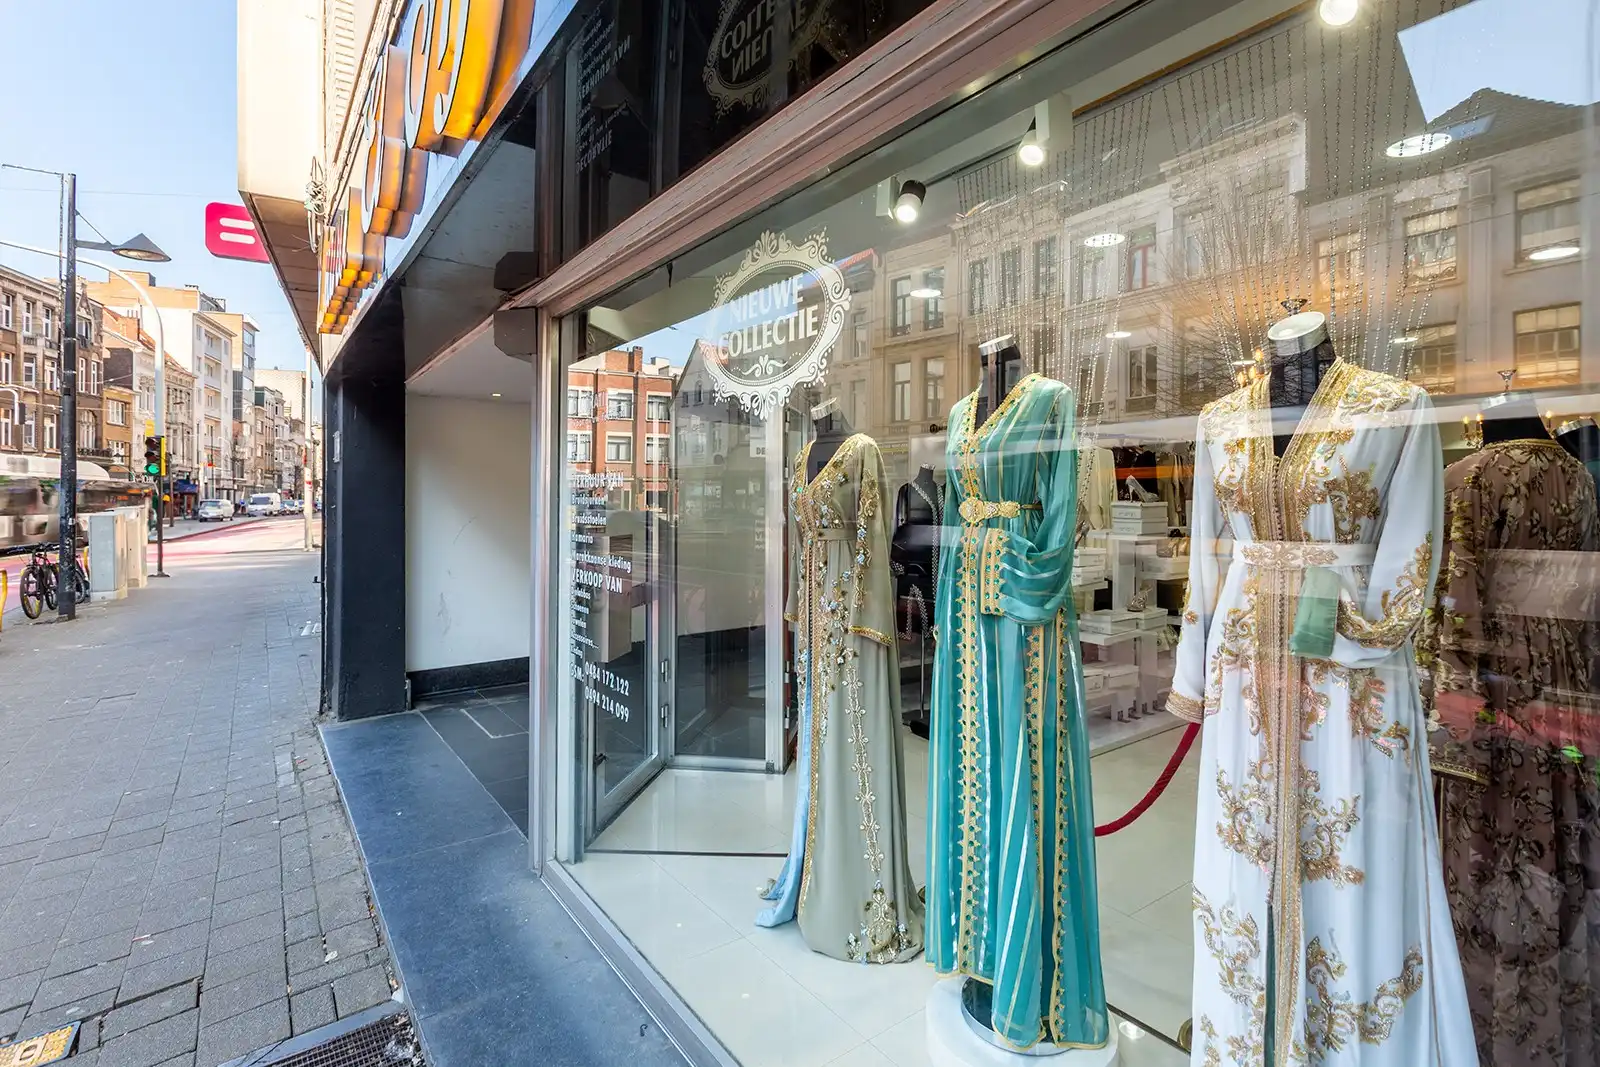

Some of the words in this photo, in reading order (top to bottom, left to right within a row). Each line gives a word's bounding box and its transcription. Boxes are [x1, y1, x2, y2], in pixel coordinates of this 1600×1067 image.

[730, 272, 804, 322] NIEUWE
[718, 304, 819, 358] COLLECTIE
[608, 554, 631, 573] kleding
[572, 568, 603, 588] VERKOOP
[605, 575, 623, 594] VAN
[602, 669, 614, 688] 172
[616, 676, 629, 696] 122
[601, 694, 614, 714] 214
[615, 702, 629, 722] 099
